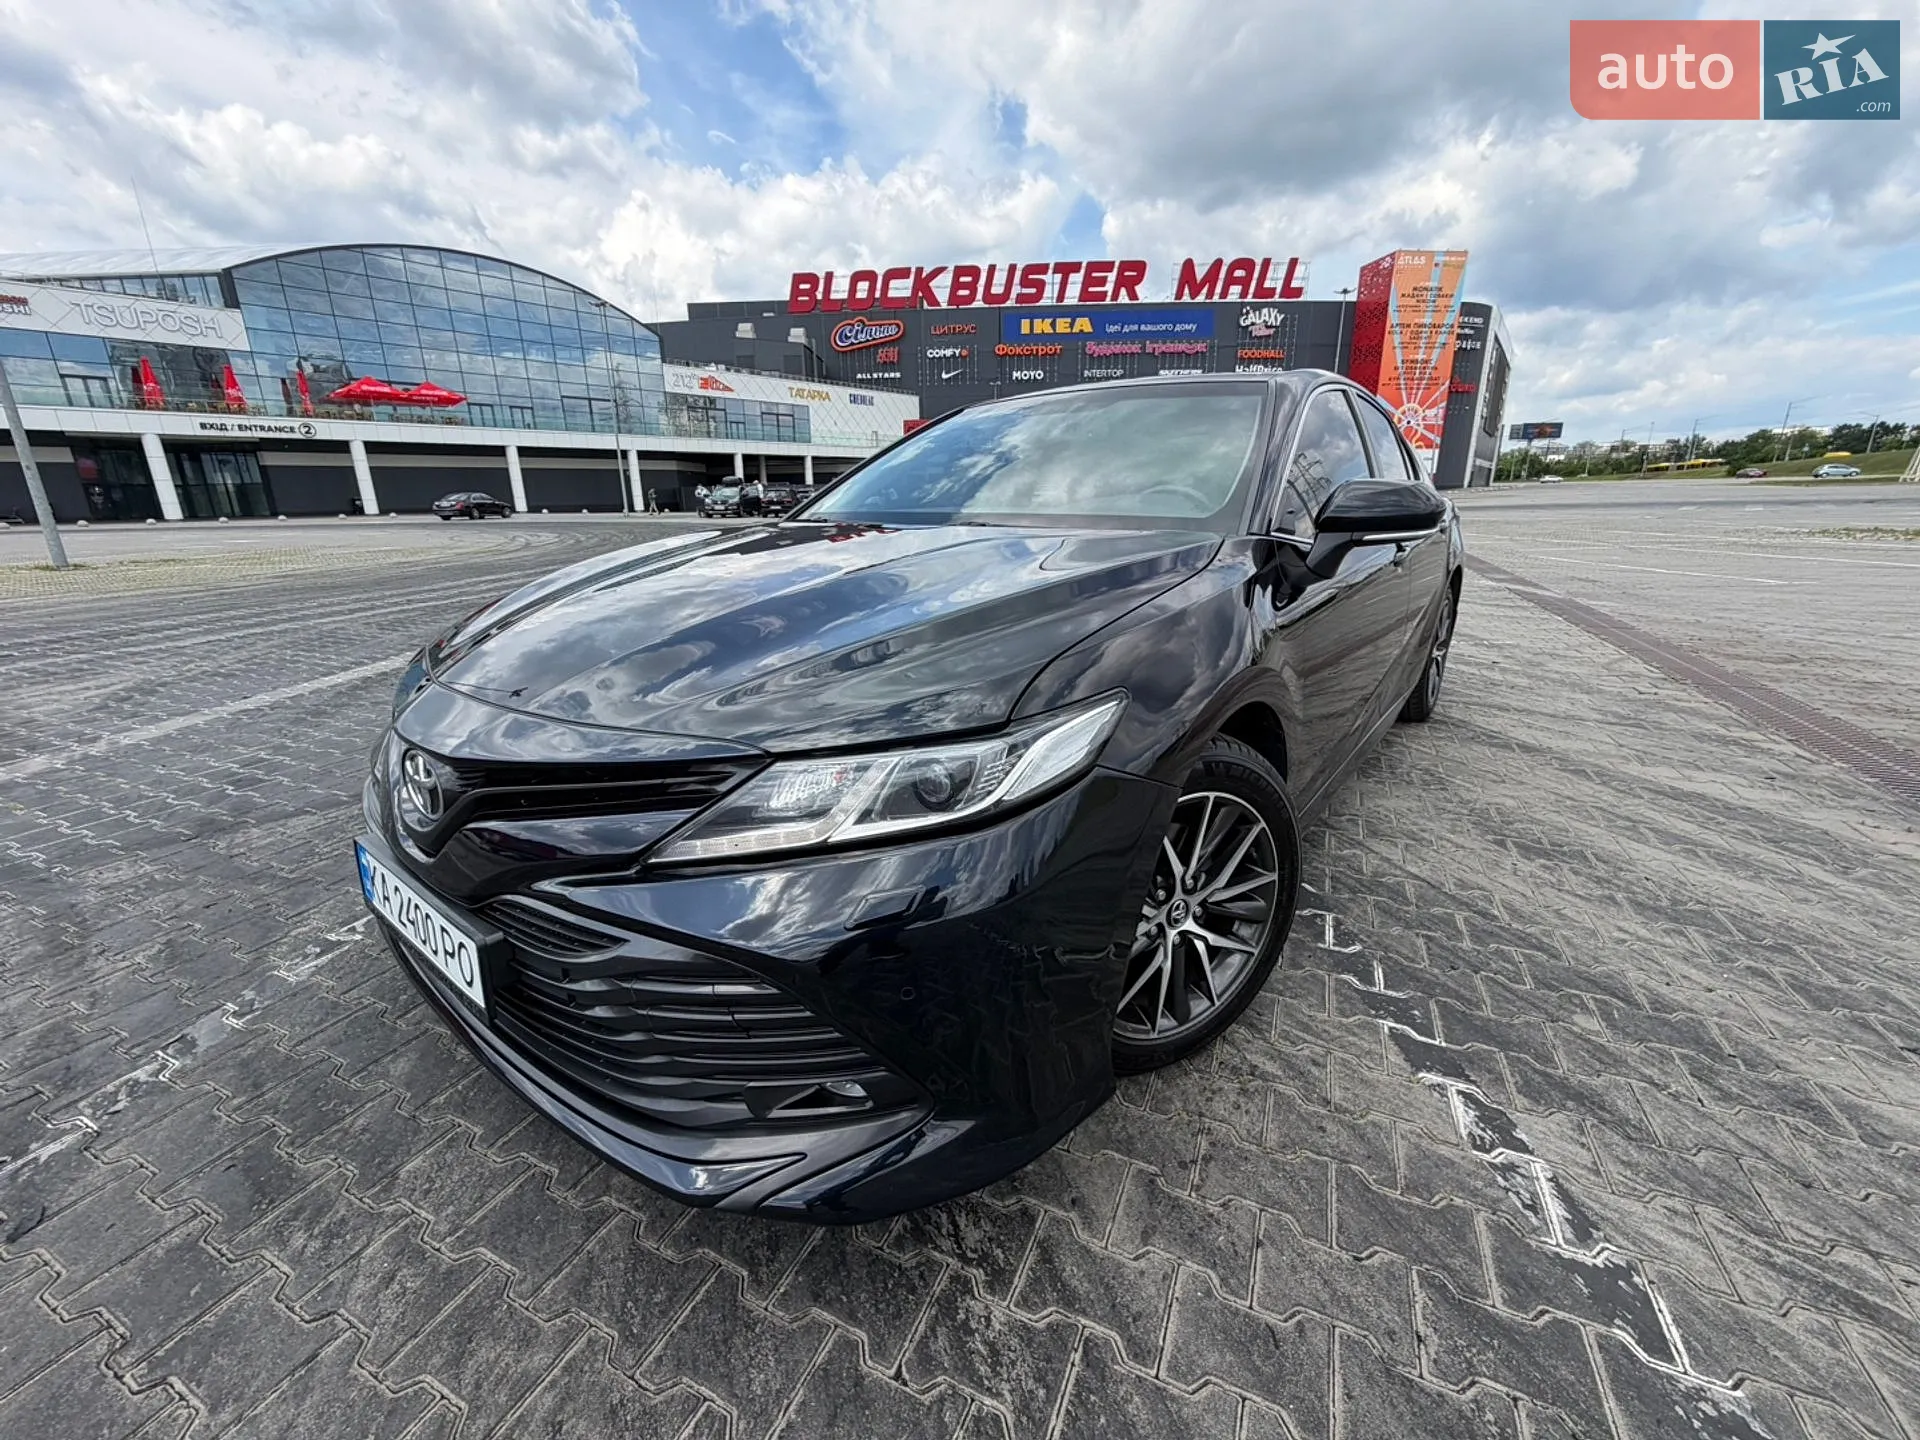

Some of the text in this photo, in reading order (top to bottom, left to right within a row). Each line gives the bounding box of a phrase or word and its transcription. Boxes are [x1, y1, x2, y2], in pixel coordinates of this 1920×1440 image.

[788, 257, 1304, 313] BLOCKBUSTER MALL
[1240, 307, 1285, 326] GALAXY
[931, 324, 977, 335] ЦИТРУС
[1021, 318, 1093, 334] IKEA
[1140, 323, 1174, 331] вашого
[1174, 323, 1198, 333] дому
[926, 348, 961, 358] COMFY
[994, 344, 1063, 356] Фокстрот
[1237, 349, 1286, 359] FOODHALL
[1012, 371, 1045, 380] MOYO
[1083, 369, 1125, 378] INTERTOP
[199, 421, 229, 432] ВХІД
[237, 423, 297, 434] ENTRANCE
[394, 885, 439, 958] 2400
[440, 925, 475, 989] PO
